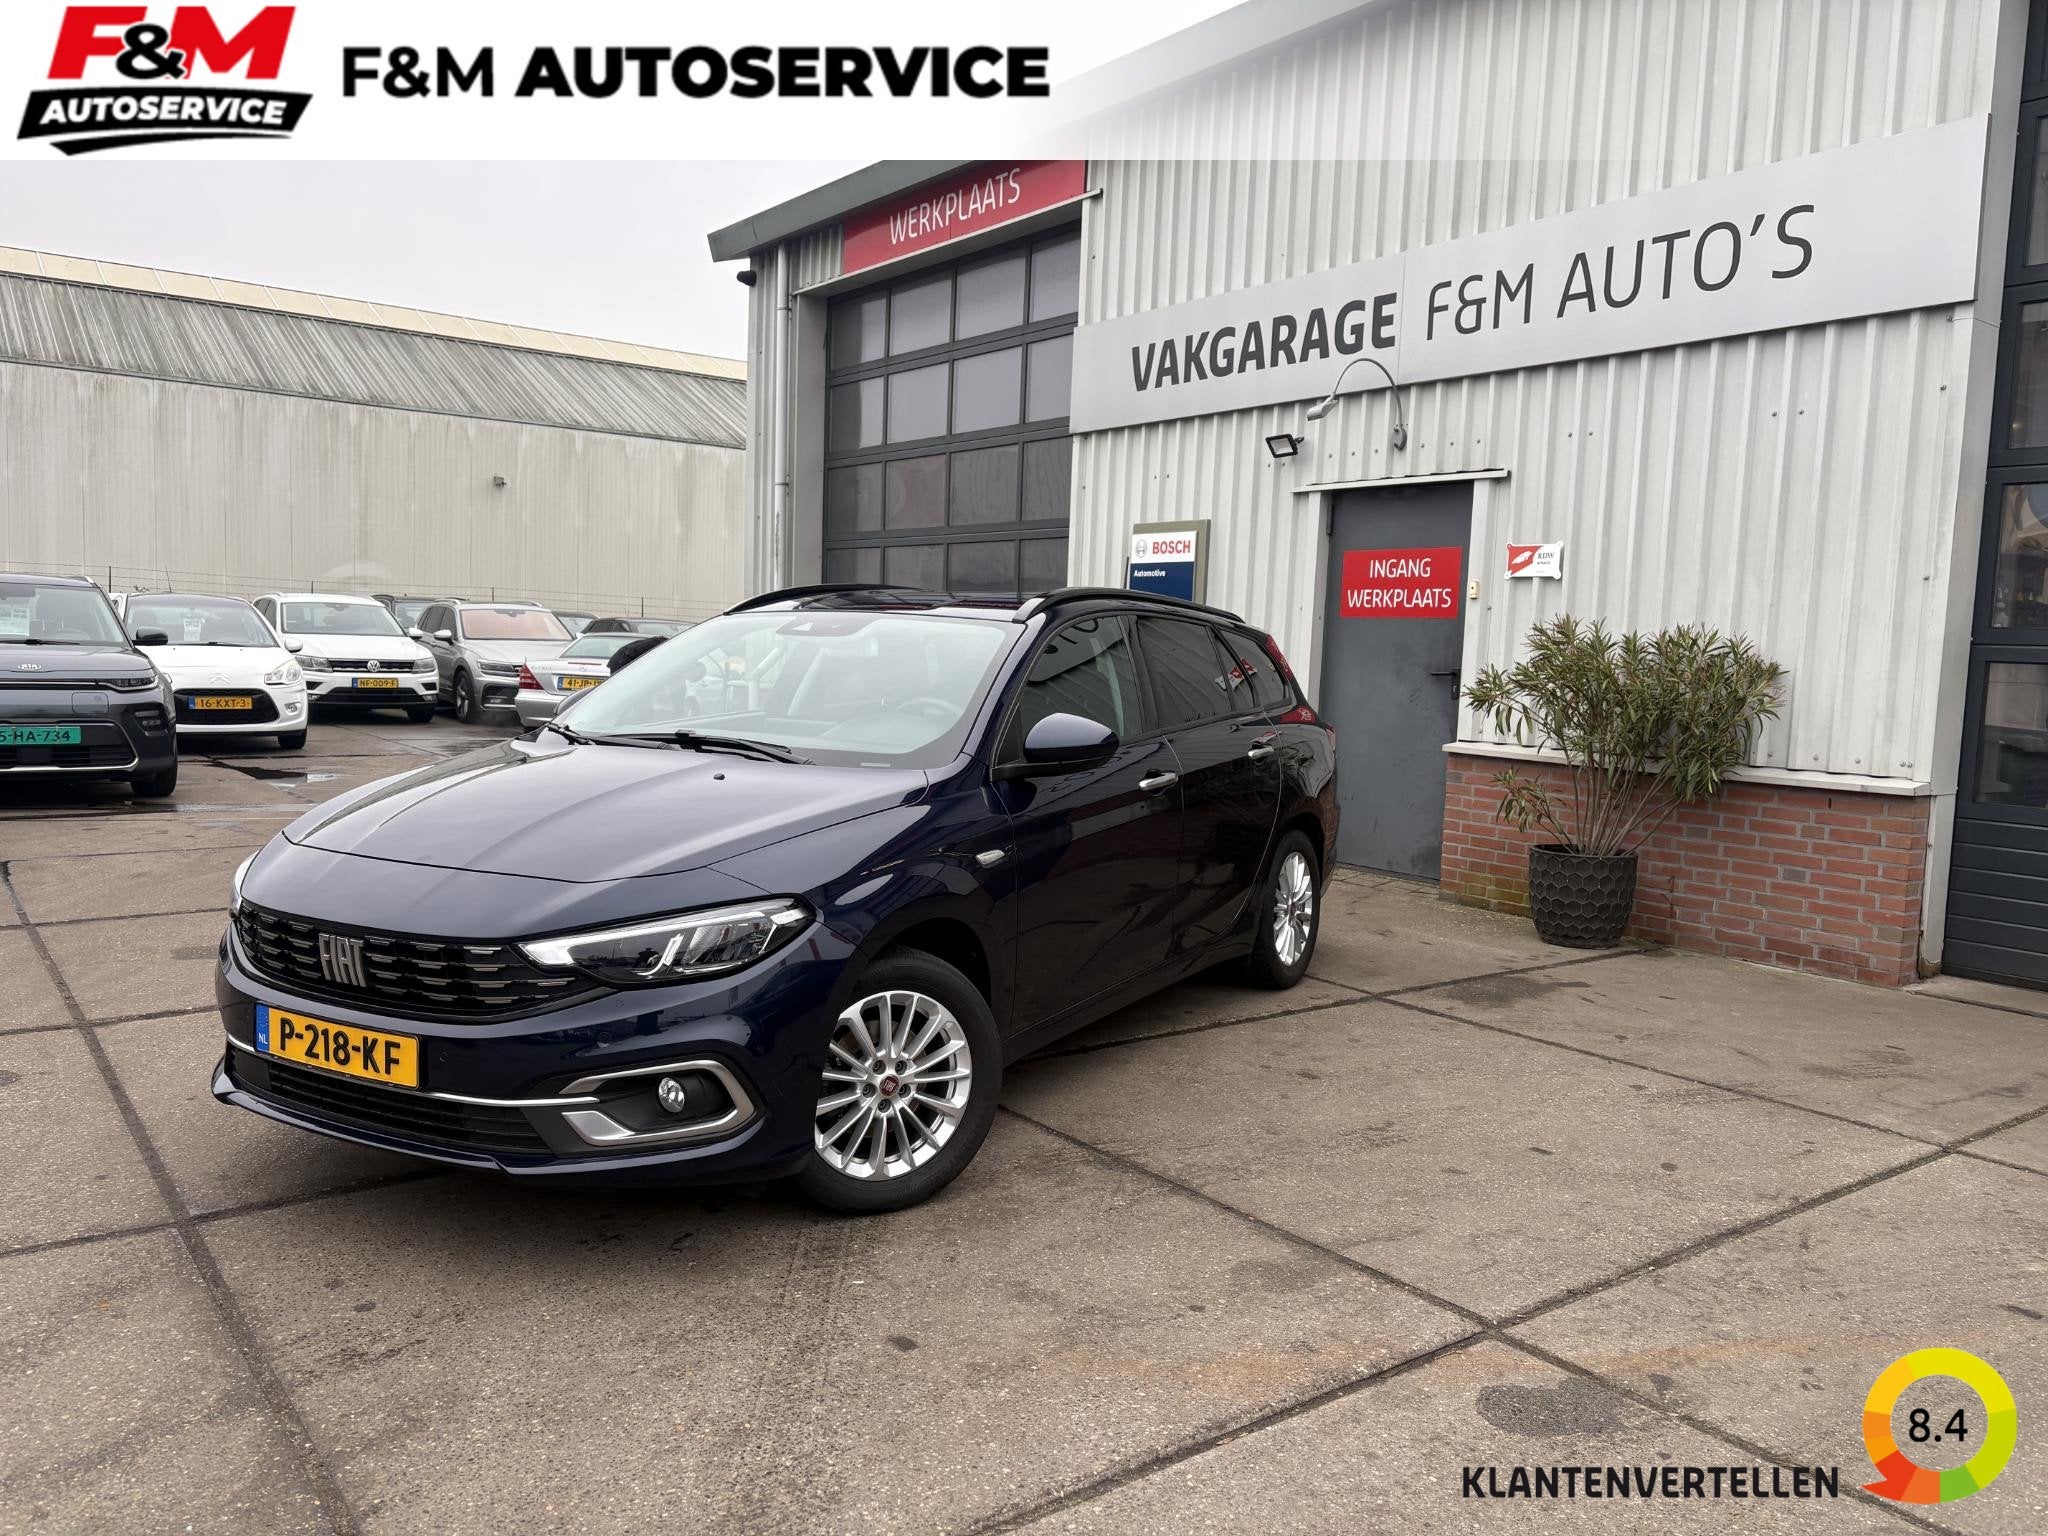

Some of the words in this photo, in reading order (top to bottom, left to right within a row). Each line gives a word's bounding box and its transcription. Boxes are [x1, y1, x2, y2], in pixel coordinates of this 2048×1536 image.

[889, 167, 1021, 246] WERKPLAATS
[1131, 291, 1398, 392] VAKGARAGE
[1426, 262, 1535, 341] F&M
[1556, 204, 1815, 320] AUTO'S
[1152, 540, 1191, 555] BOSCH
[1133, 568, 1166, 577] Automotive
[1369, 557, 1432, 579] INGANG
[1347, 588, 1452, 609] WERKPLAATS
[200, 698, 247, 708] 16-KXT-3
[318, 933, 367, 987] FIAT
[258, 1032, 268, 1045] NL
[279, 1016, 401, 1076] P-218-KF
